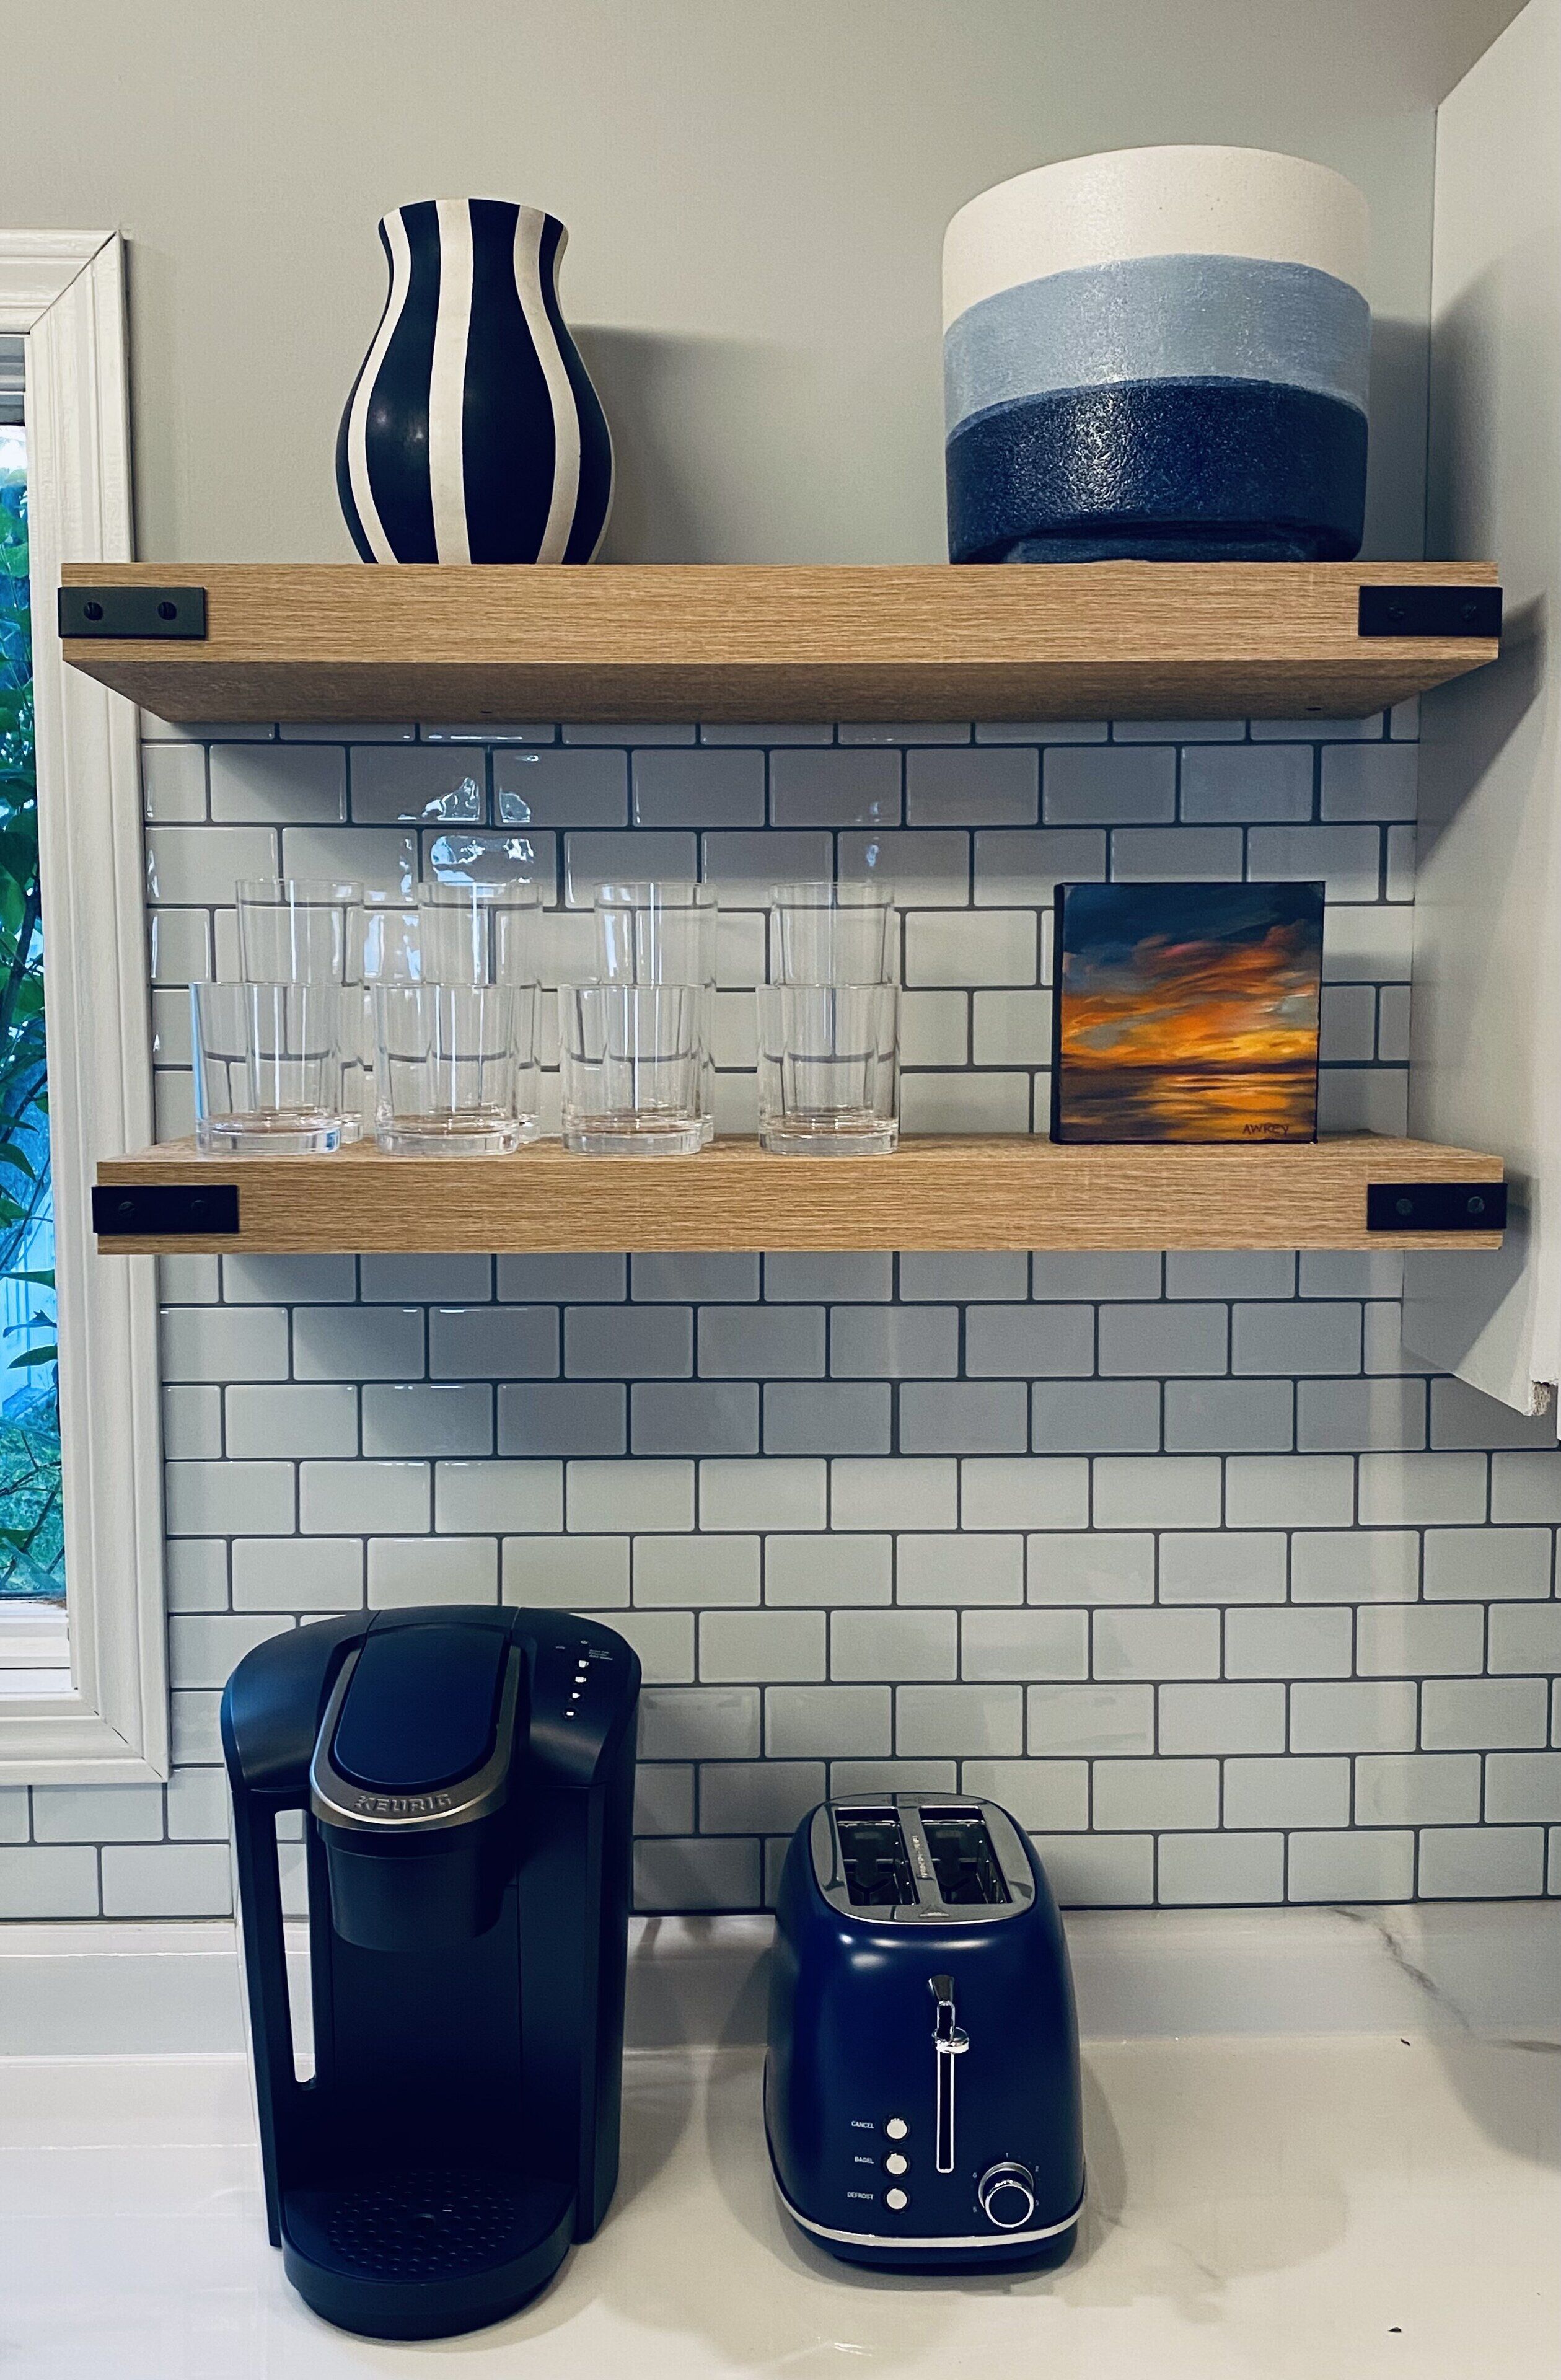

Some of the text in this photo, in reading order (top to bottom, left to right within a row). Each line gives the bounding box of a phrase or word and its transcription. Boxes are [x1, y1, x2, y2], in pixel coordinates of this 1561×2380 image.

[1242, 1123, 1290, 1135] AWREY
[354, 1793, 451, 1812] KEURIG
[851, 2121, 874, 2129] CANCEL
[847, 2192, 874, 2200] DEFROST
